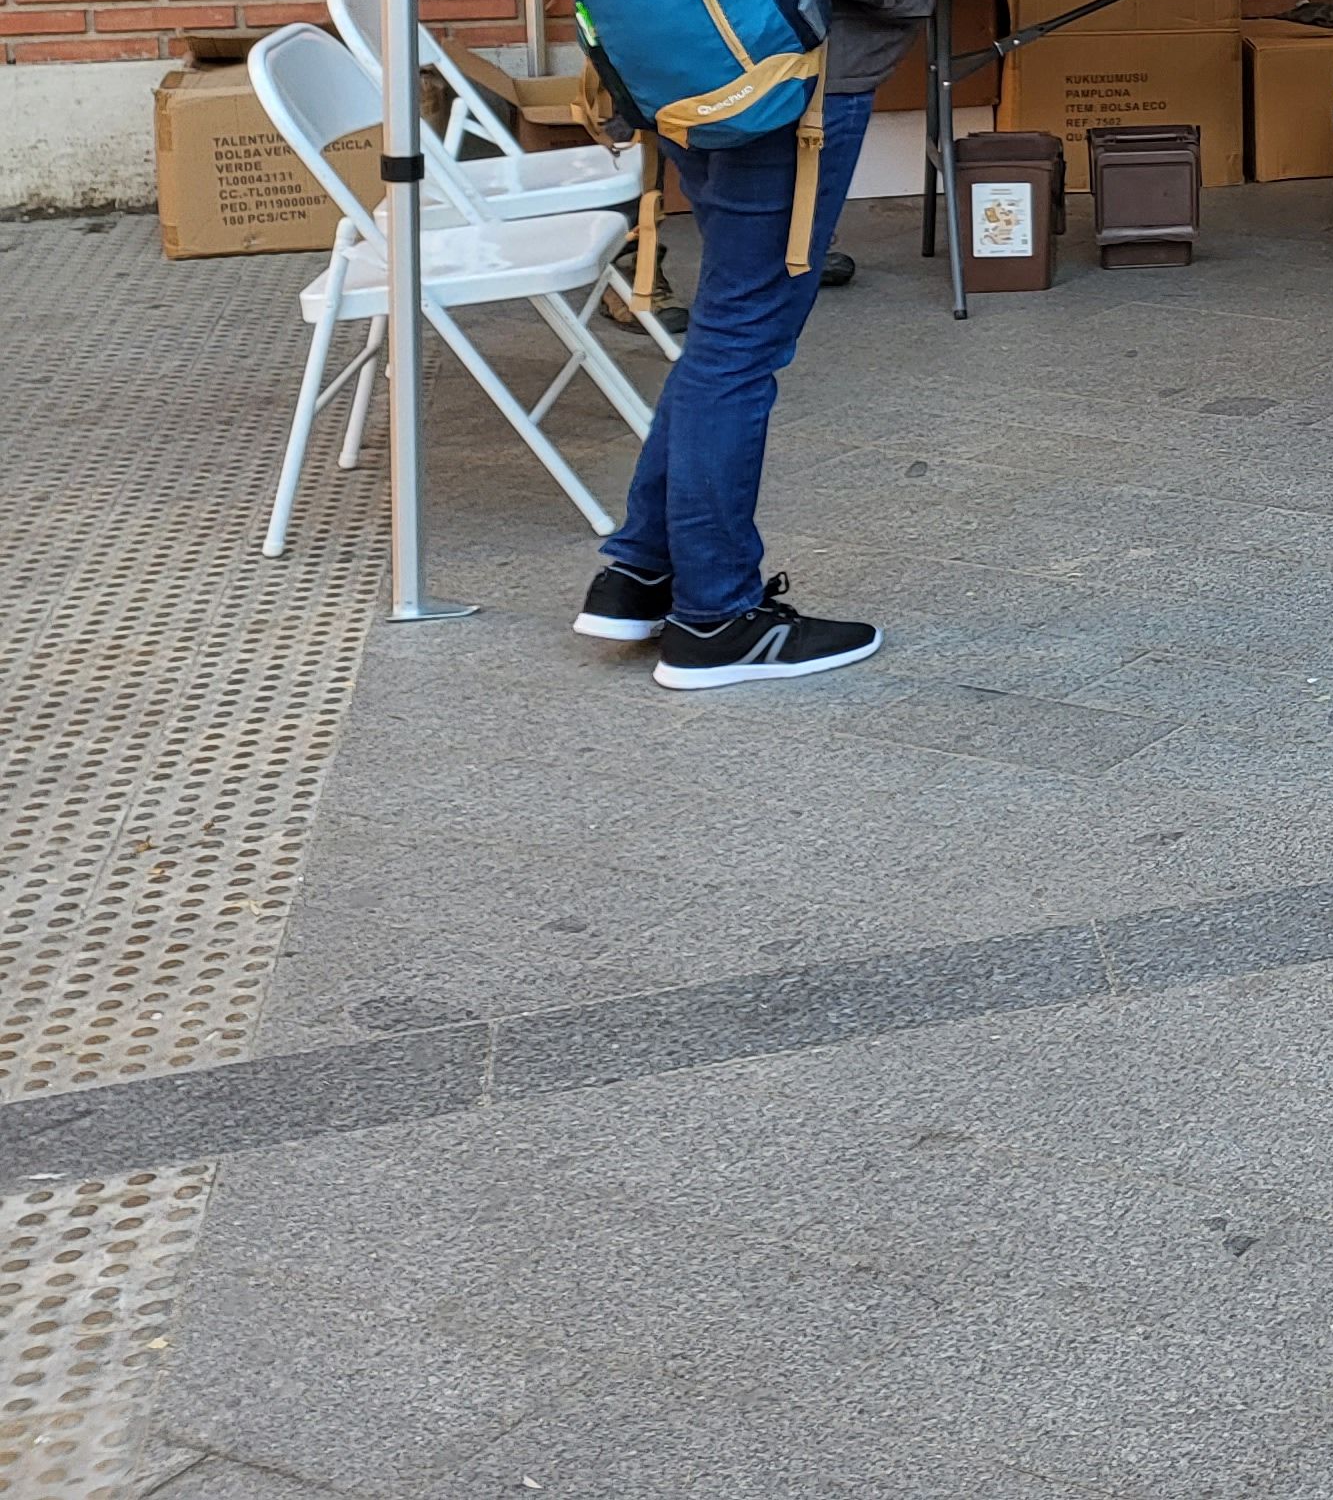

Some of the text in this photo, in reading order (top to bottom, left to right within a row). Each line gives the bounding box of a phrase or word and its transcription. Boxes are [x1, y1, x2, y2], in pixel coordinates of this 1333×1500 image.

[1065, 88, 1132, 99] PAMPLONA
[1100, 102, 1140, 112] BOLSA
[1142, 101, 1167, 111] ECO
[214, 147, 261, 161] BOLSA
[215, 161, 263, 174] VERDE
